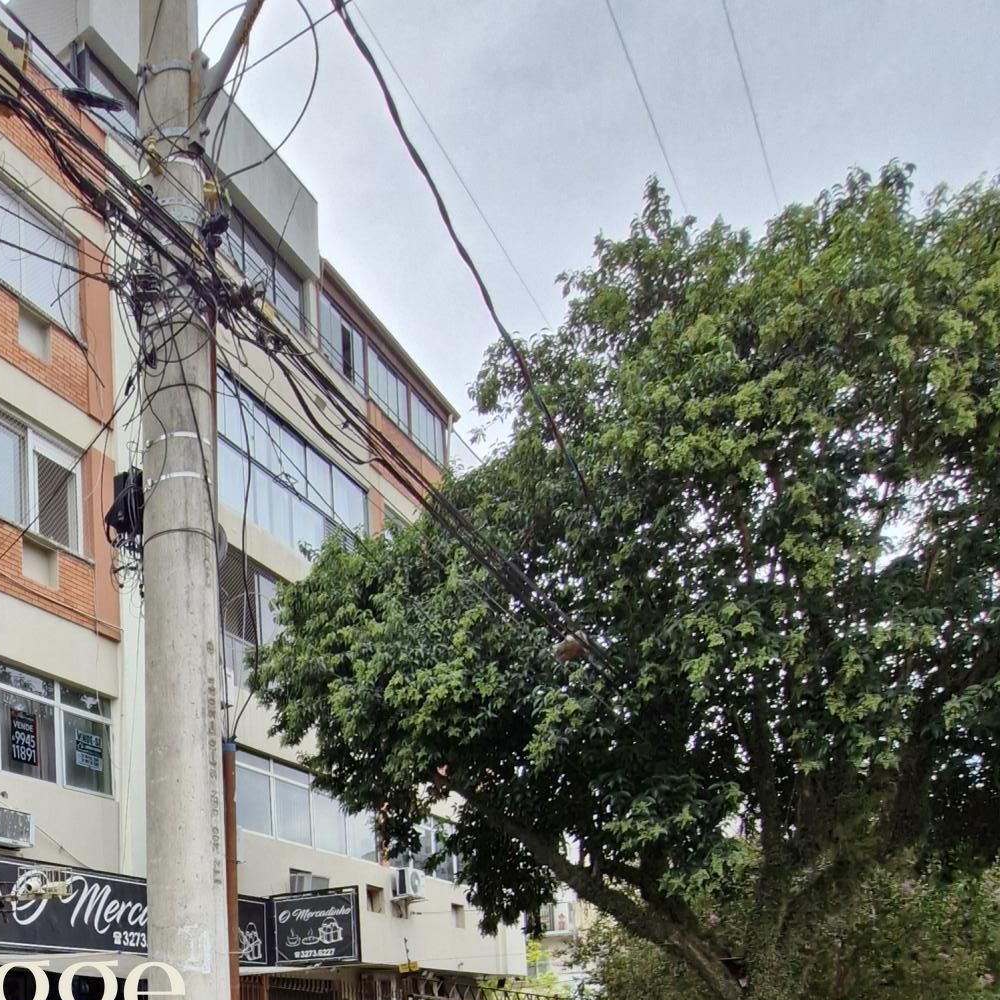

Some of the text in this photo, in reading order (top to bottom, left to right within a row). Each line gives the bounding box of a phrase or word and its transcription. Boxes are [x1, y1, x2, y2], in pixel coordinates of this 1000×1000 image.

[13, 720, 34, 732] VENDE
[15, 731, 35, 749] 9945
[12, 744, 36, 763] 11891
[279, 904, 352, 924] O Mercadinho
